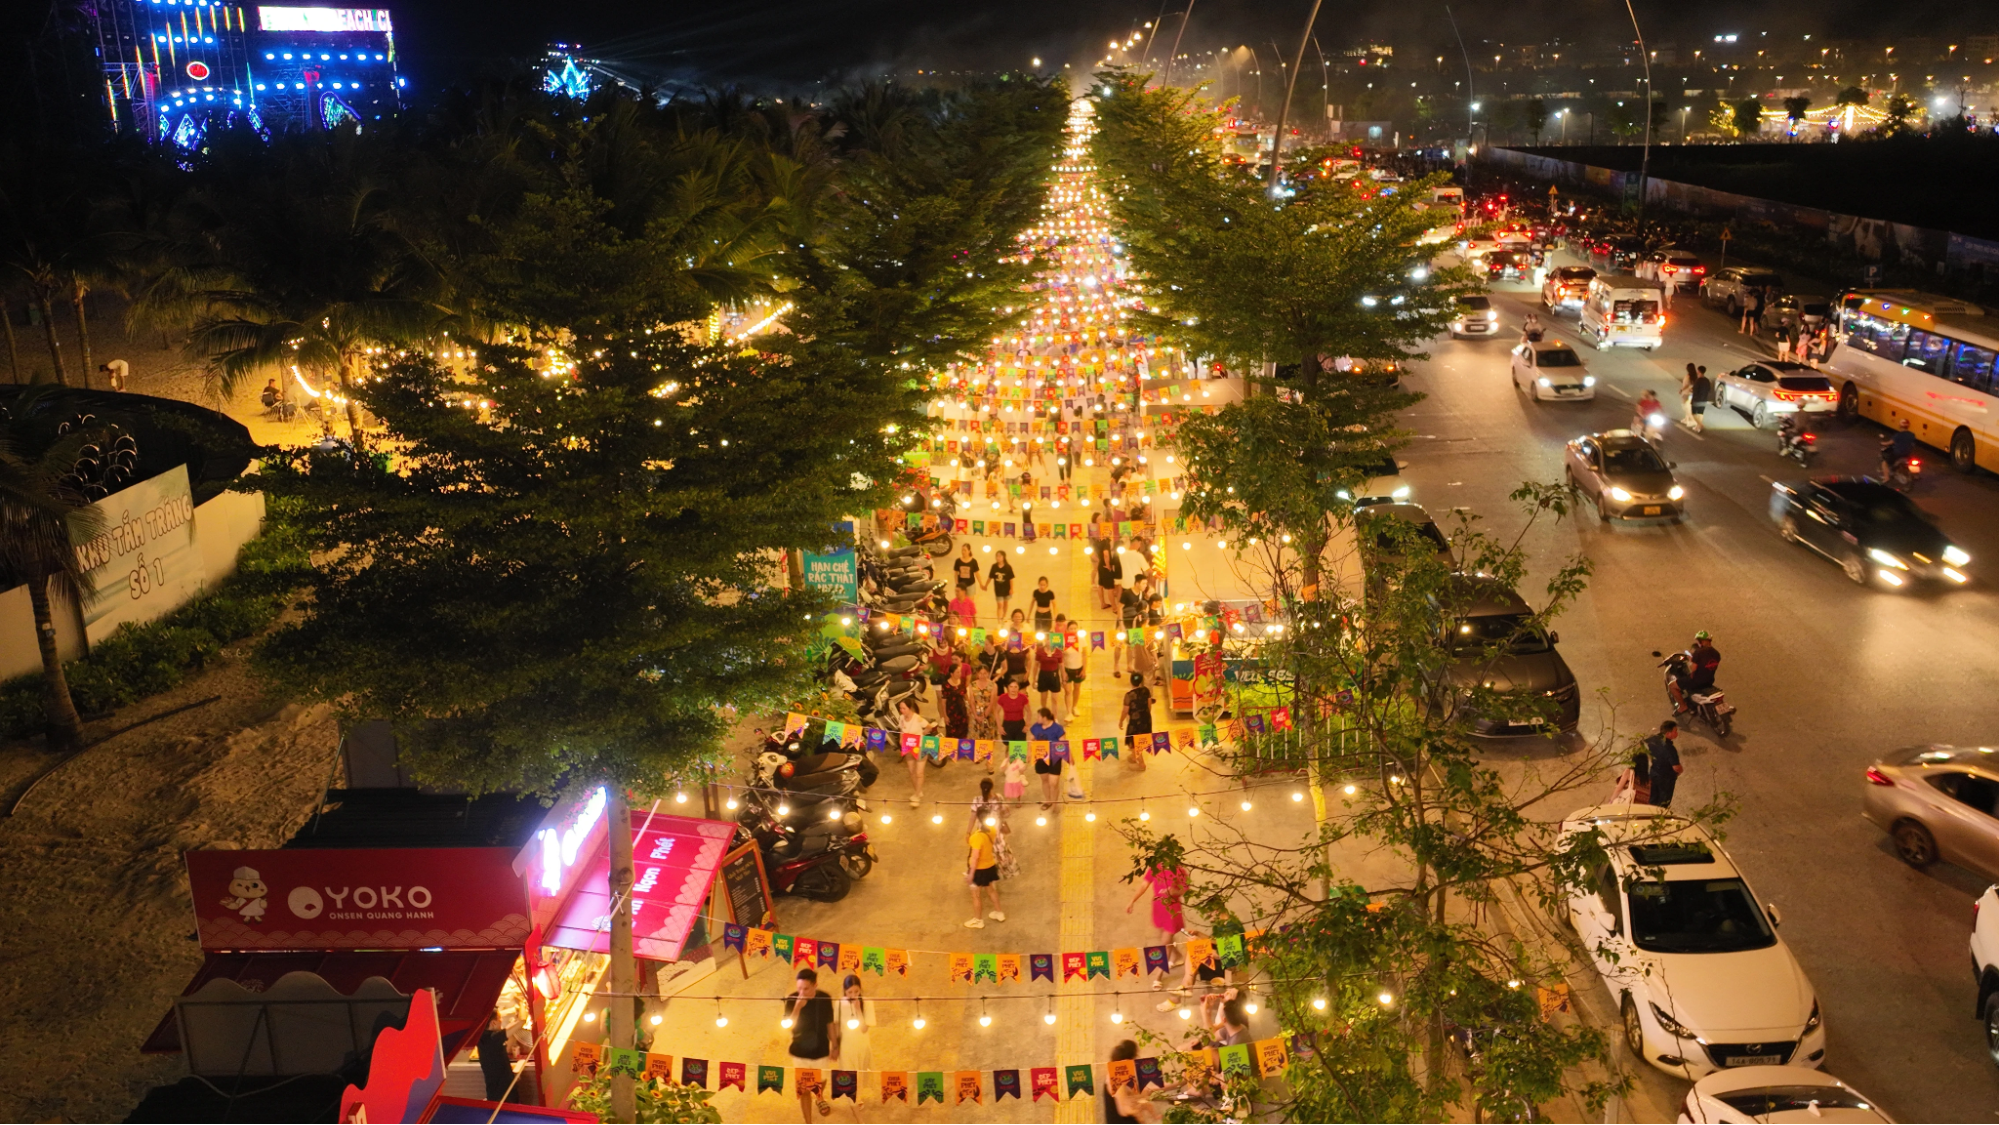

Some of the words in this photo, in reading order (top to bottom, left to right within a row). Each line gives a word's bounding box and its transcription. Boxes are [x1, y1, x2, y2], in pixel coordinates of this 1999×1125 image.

[1868, 265, 1878, 277] P
[128, 552, 152, 600] SỐ
[153, 558, 164, 587] 1
[325, 885, 433, 909] YOKO
[329, 911, 364, 920] ONSEN
[366, 911, 402, 920] QUANG
[406, 911, 434, 920] HANH
